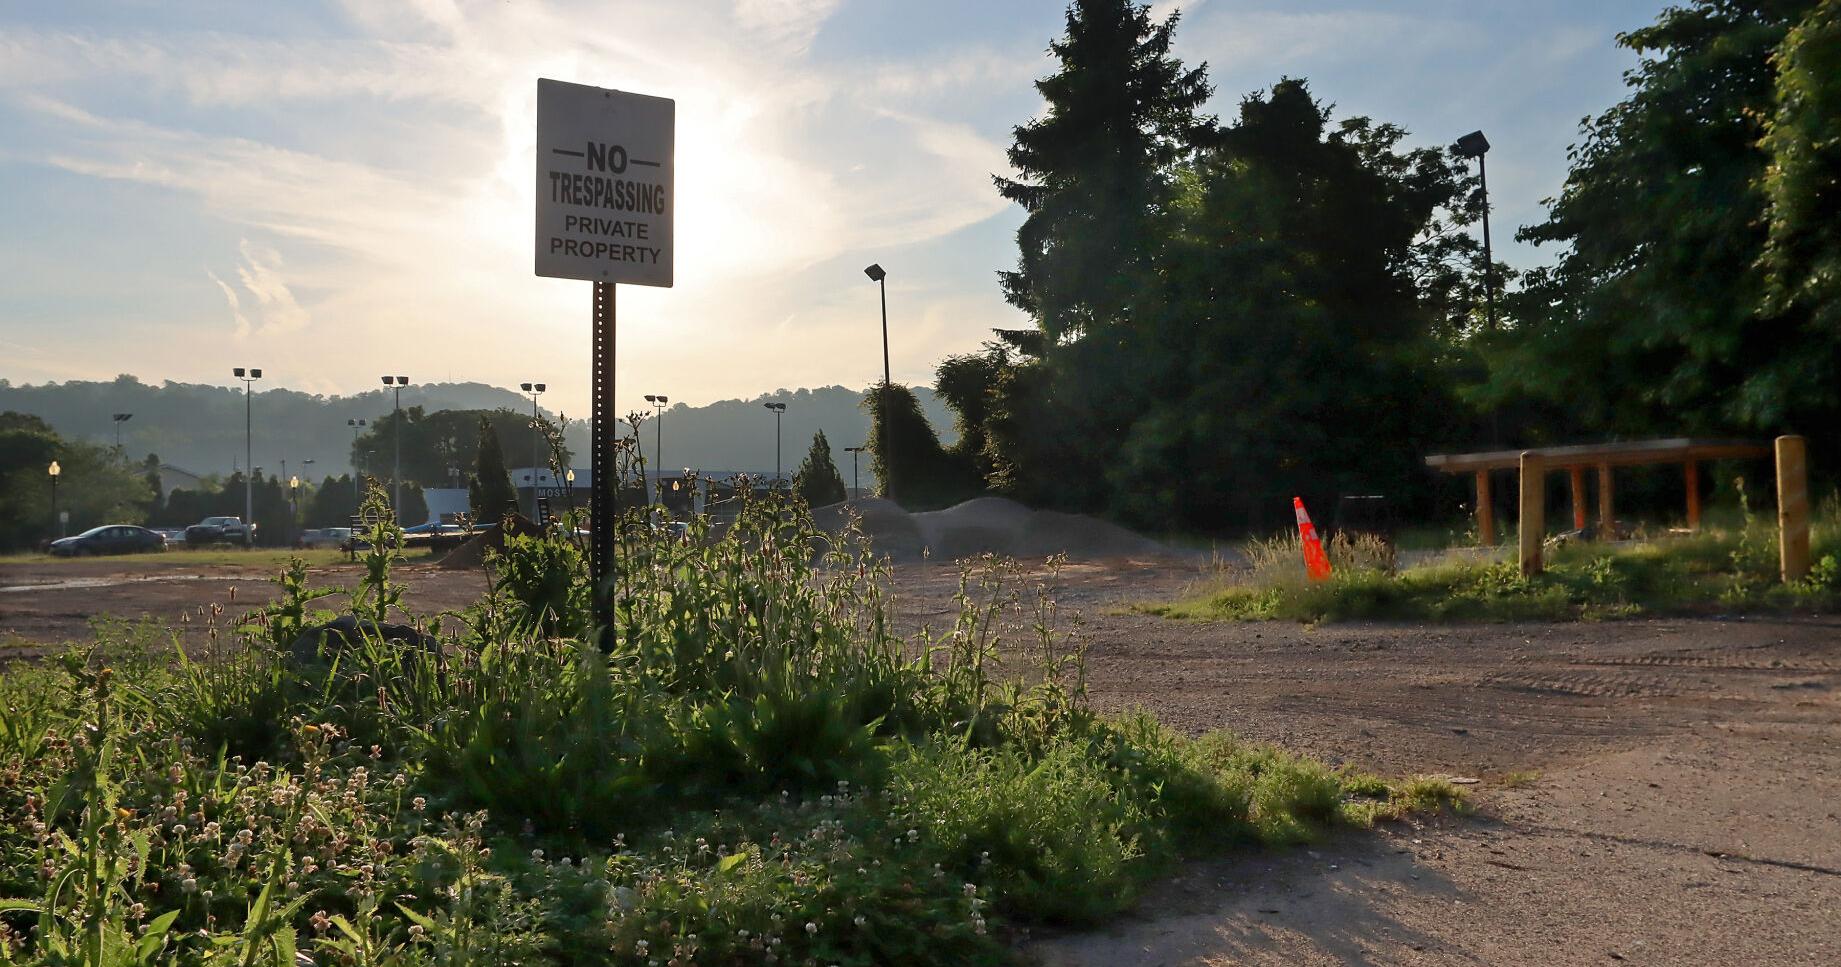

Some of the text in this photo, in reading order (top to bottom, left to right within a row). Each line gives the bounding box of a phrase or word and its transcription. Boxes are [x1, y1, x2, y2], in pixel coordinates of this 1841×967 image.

[587, 142, 628, 174] NO
[549, 171, 665, 215] TRESPASSING
[565, 215, 649, 240] PRIVATE
[550, 237, 661, 264] PROPERTY
[538, 488, 572, 498] MOSE
